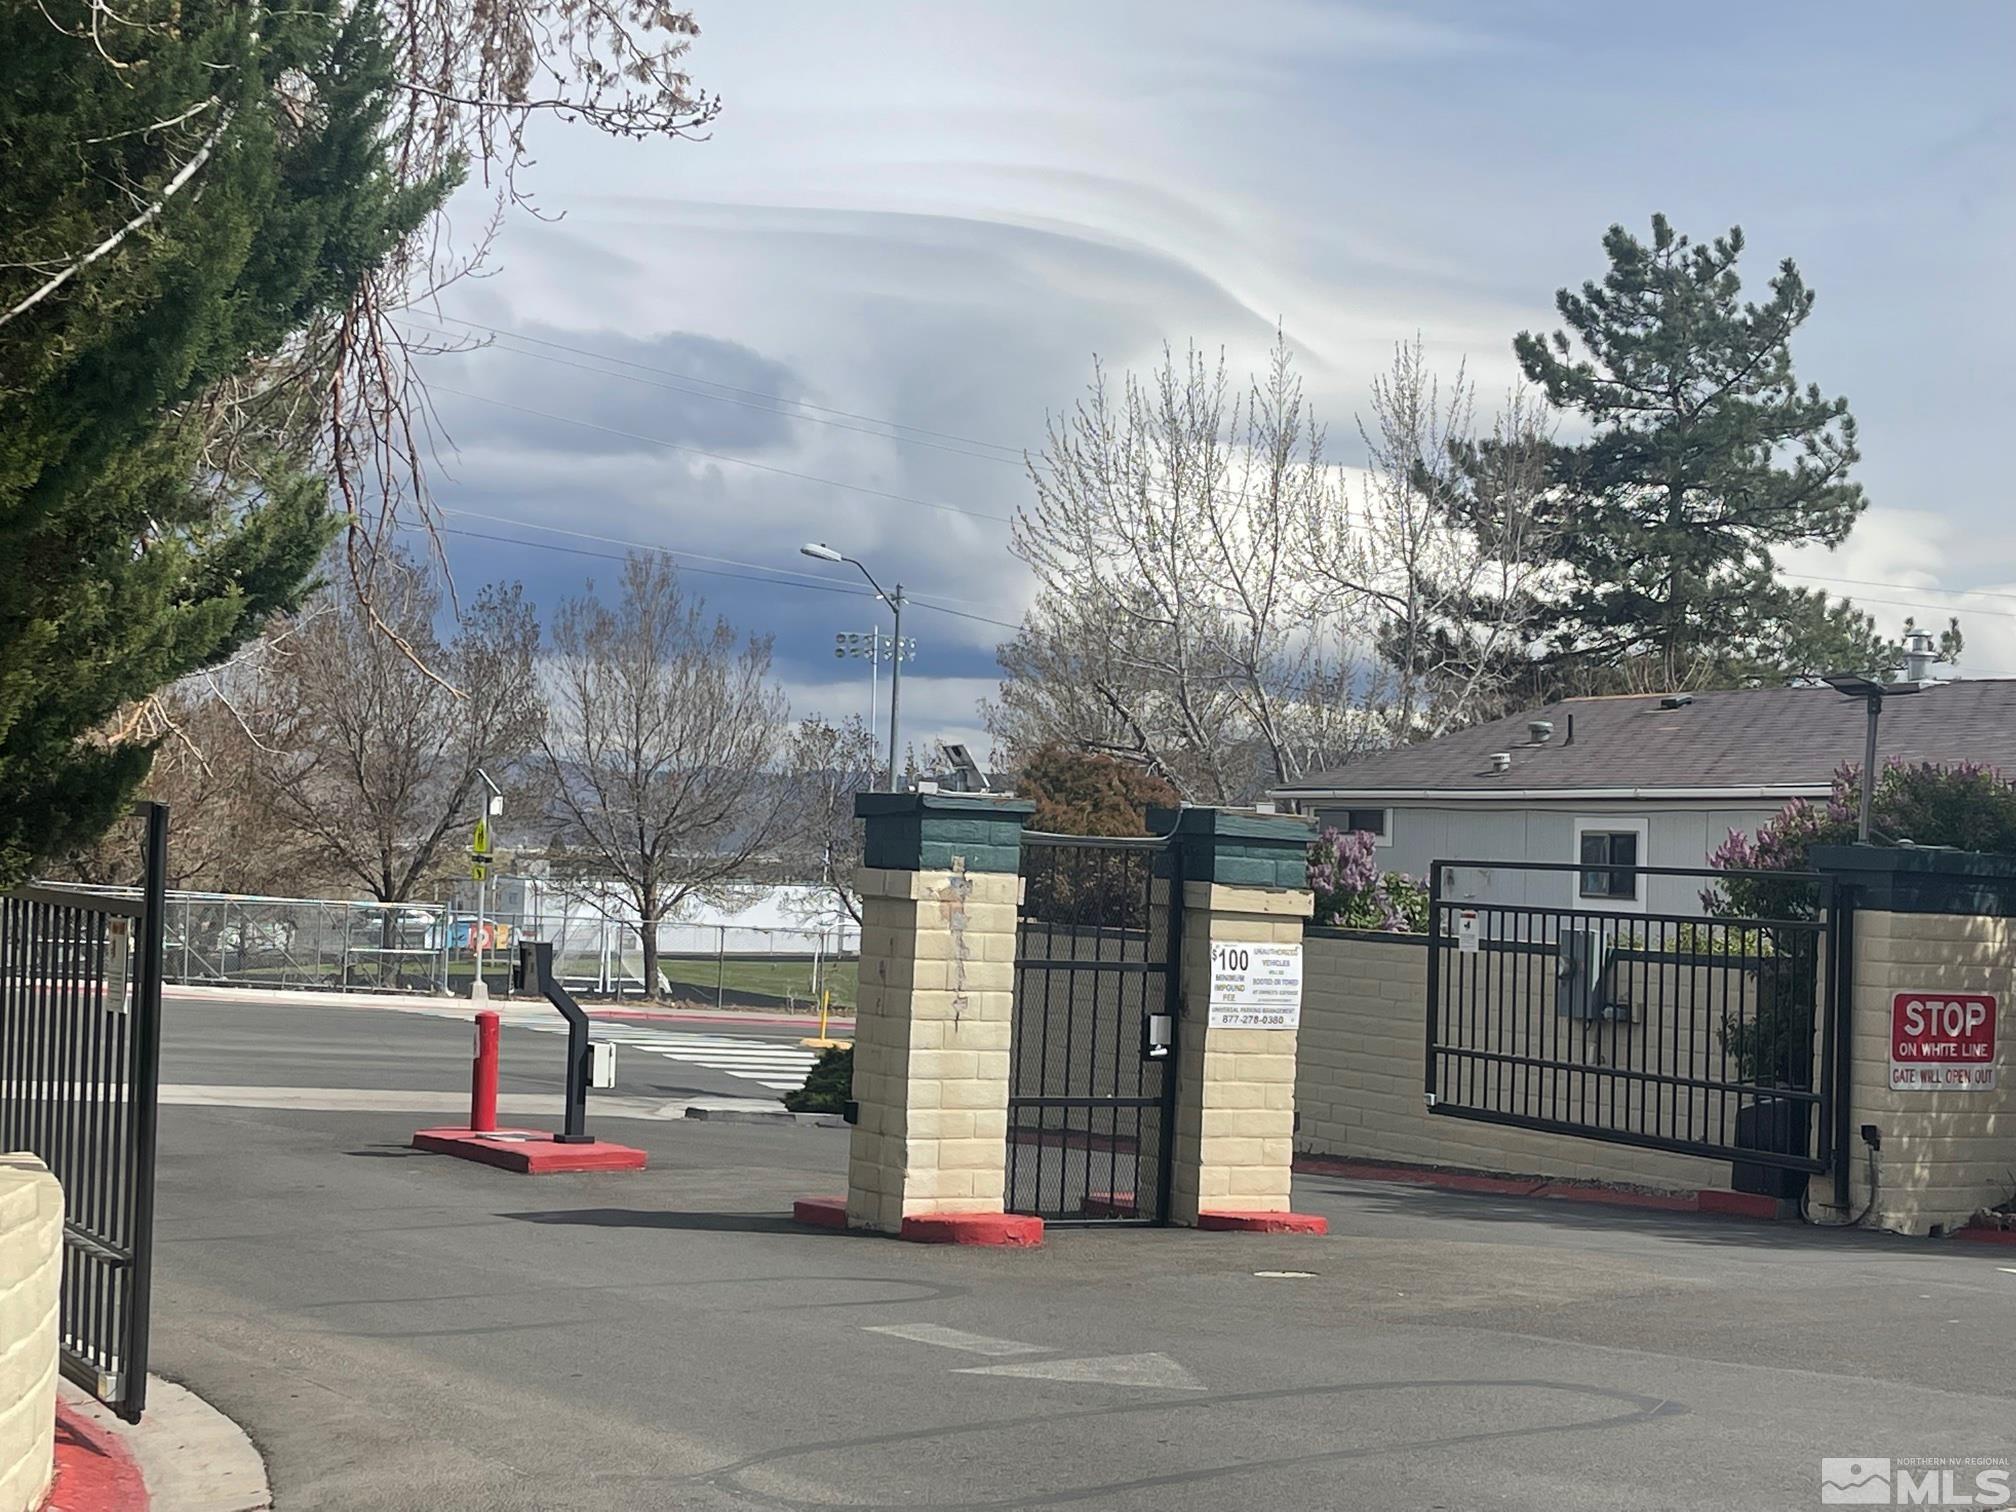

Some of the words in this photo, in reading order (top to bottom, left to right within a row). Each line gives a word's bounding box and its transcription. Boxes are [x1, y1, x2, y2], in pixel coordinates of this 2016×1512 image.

[1212, 947, 1249, 971] $100
[1214, 984, 1246, 992] IMPOUND
[1904, 1000, 1986, 1037] STOP
[1899, 1042, 1917, 1056] ON
[1921, 1043, 1958, 1057] WHITE
[1961, 1043, 1988, 1057] LINE
[1892, 1068, 1916, 1084] GATE
[1920, 1069, 1942, 1084] WILL
[1945, 1069, 1971, 1084] OPEN
[1974, 1069, 1993, 1084] OUT
